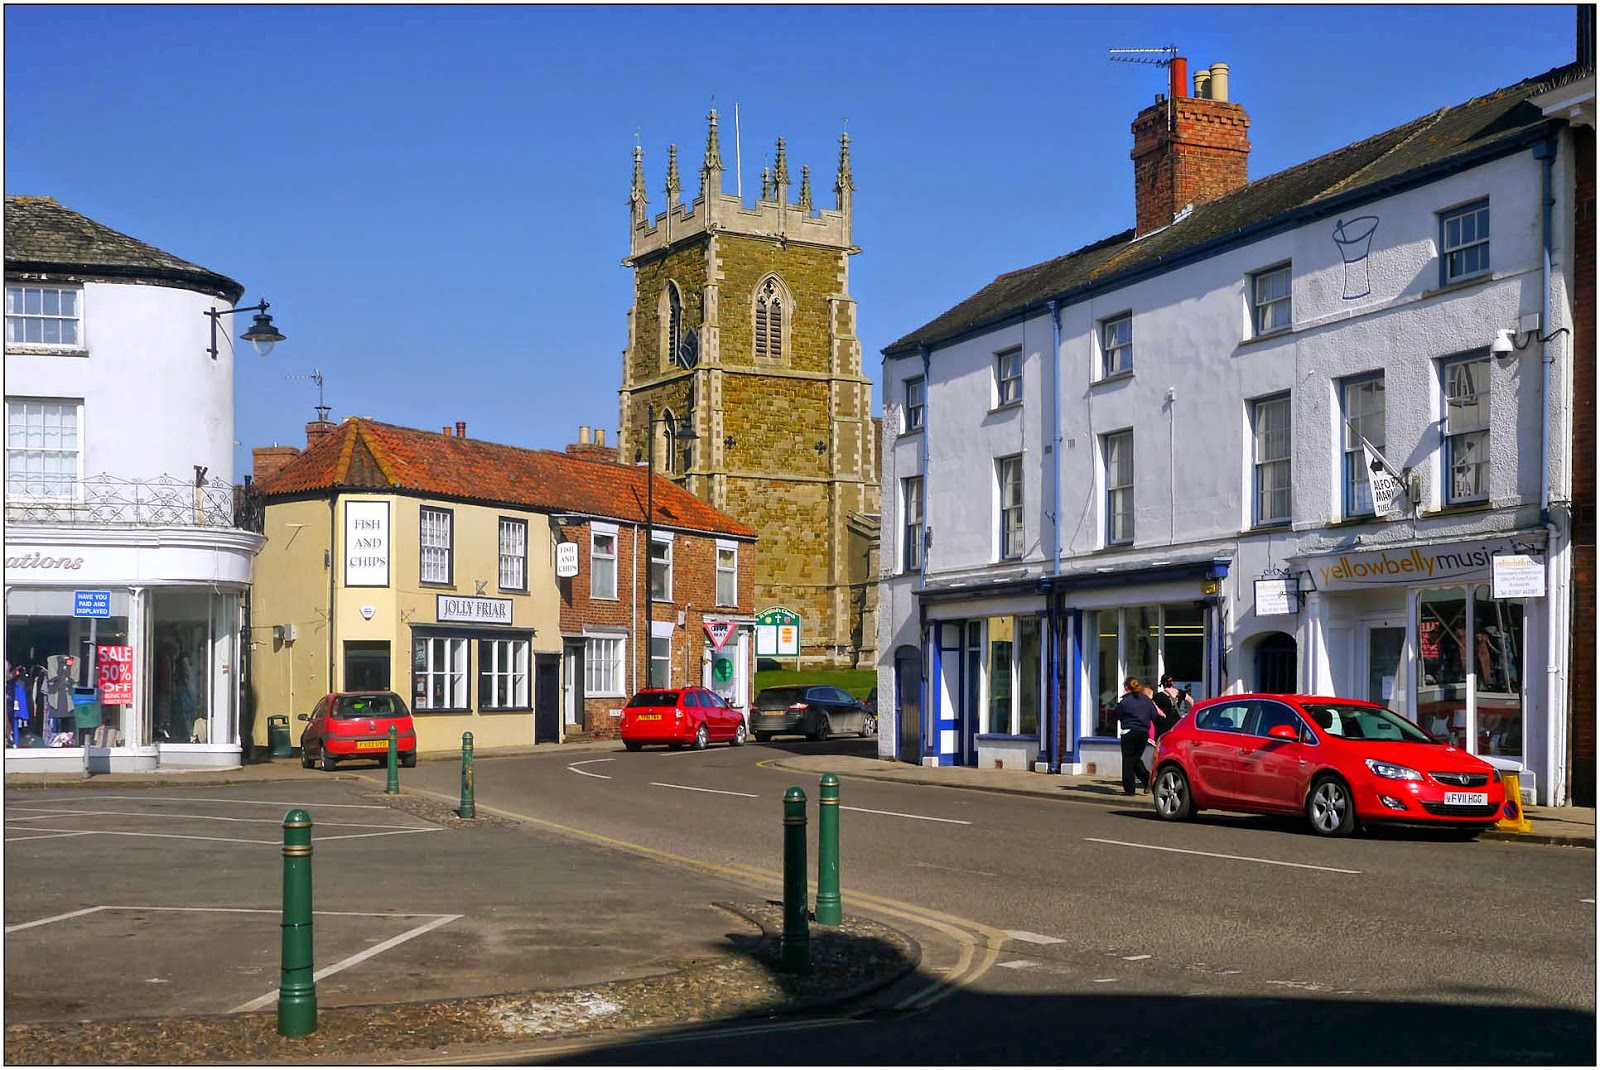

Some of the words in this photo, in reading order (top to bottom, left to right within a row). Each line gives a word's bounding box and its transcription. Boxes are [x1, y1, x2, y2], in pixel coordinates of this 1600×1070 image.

[353, 519, 381, 530] FISH
[353, 538, 382, 549] AND
[349, 556, 386, 568] CHIPS
[558, 564, 577, 572] CHIPS
[1320, 549, 1435, 586] yellowbelly
[444, 600, 475, 618] JOLLY
[476, 602, 507, 618] FRIAR
[100, 646, 131, 662] SALE
[101, 663, 131, 681] 50%
[101, 682, 131, 692] OFF
